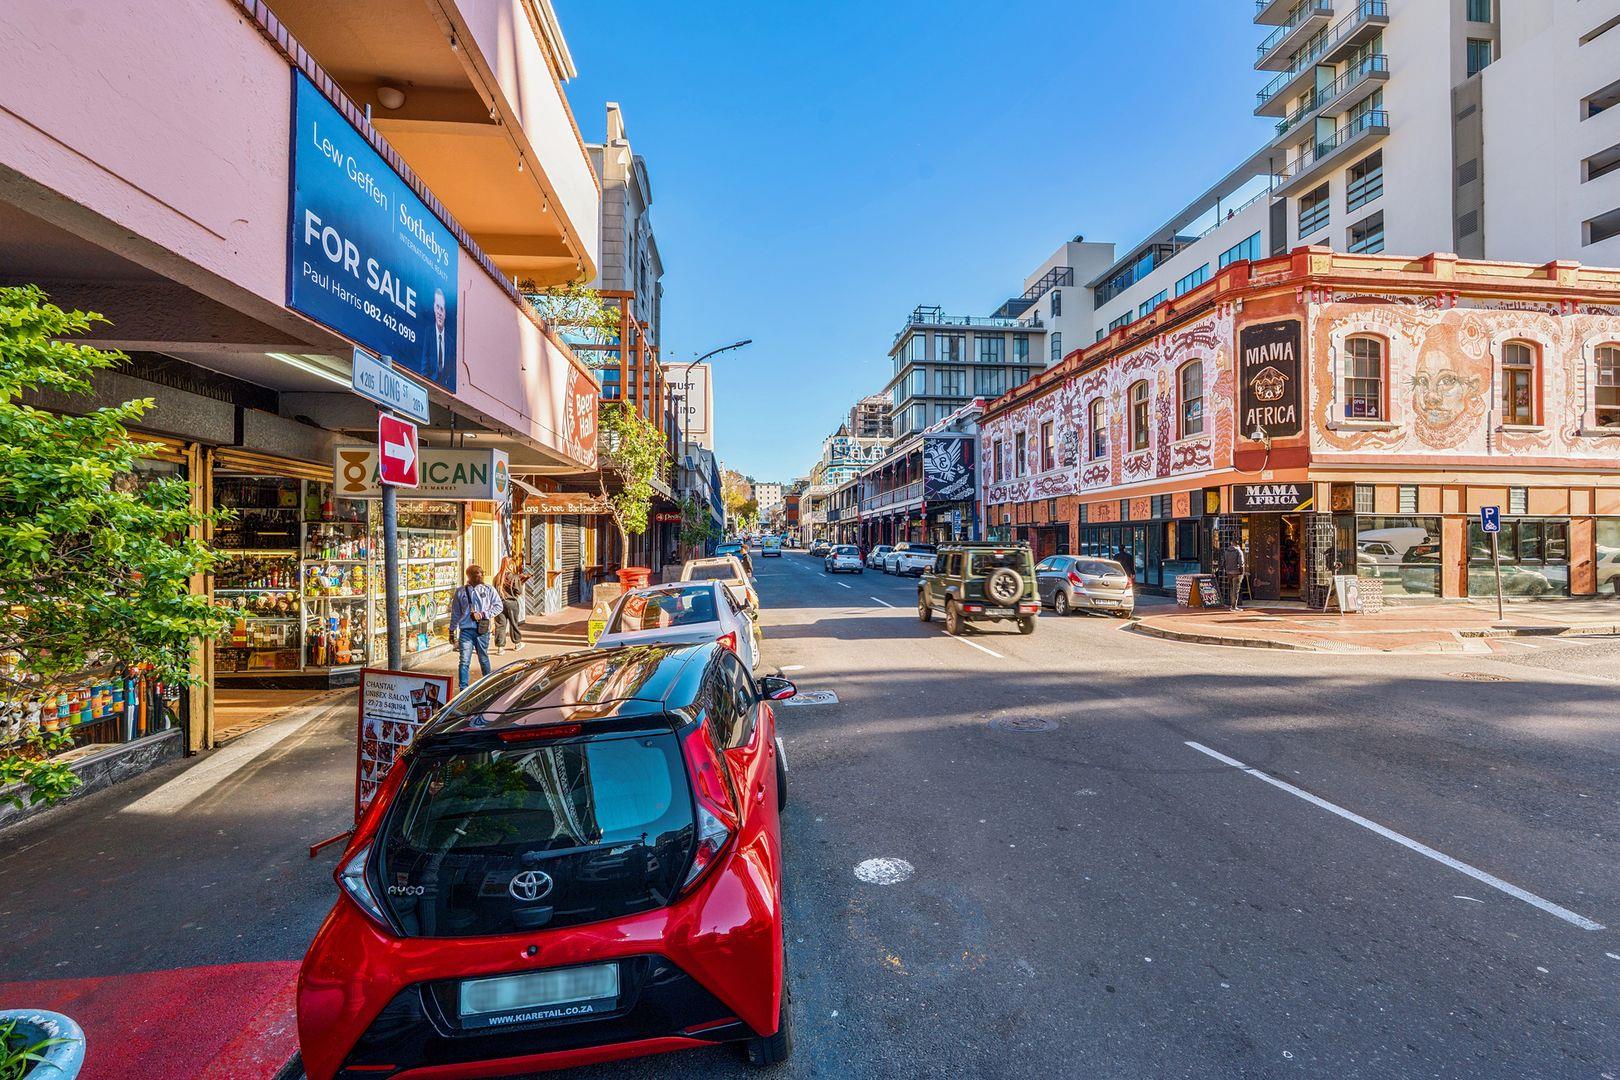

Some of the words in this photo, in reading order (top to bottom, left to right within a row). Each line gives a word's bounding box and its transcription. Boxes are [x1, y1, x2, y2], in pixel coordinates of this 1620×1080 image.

[313, 121, 343, 168] Lew
[346, 156, 388, 211] Geffen
[400, 203, 449, 267] Sotheby's
[304, 208, 360, 279] FOR
[366, 257, 417, 319] SALE
[303, 261, 329, 290] Paul
[332, 279, 362, 310] Harris
[363, 301, 381, 322] 082
[383, 313, 397, 332] 412
[398, 322, 416, 343] 0919
[1246, 341, 1294, 367] MAMA
[364, 371, 375, 390] 205
[379, 370, 400, 402] LONG
[402, 383, 409, 399] ST
[575, 392, 594, 417] Beer
[679, 406, 696, 415] IND
[1246, 404, 1296, 427] AFRICA
[579, 411, 594, 440] Hall
[371, 461, 487, 485] AICAN
[1245, 484, 1300, 496] MAMA
[1245, 495, 1300, 505] AFRICA
[523, 503, 539, 514] Long
[541, 503, 565, 513] Street
[1485, 507, 1495, 519] P
[365, 690, 387, 699] UNISEX
[388, 693, 410, 702] SALON
[387, 885, 425, 896] AYGO
[488, 1004, 594, 1026] WWW.KIARETAIL.CO.ZA
